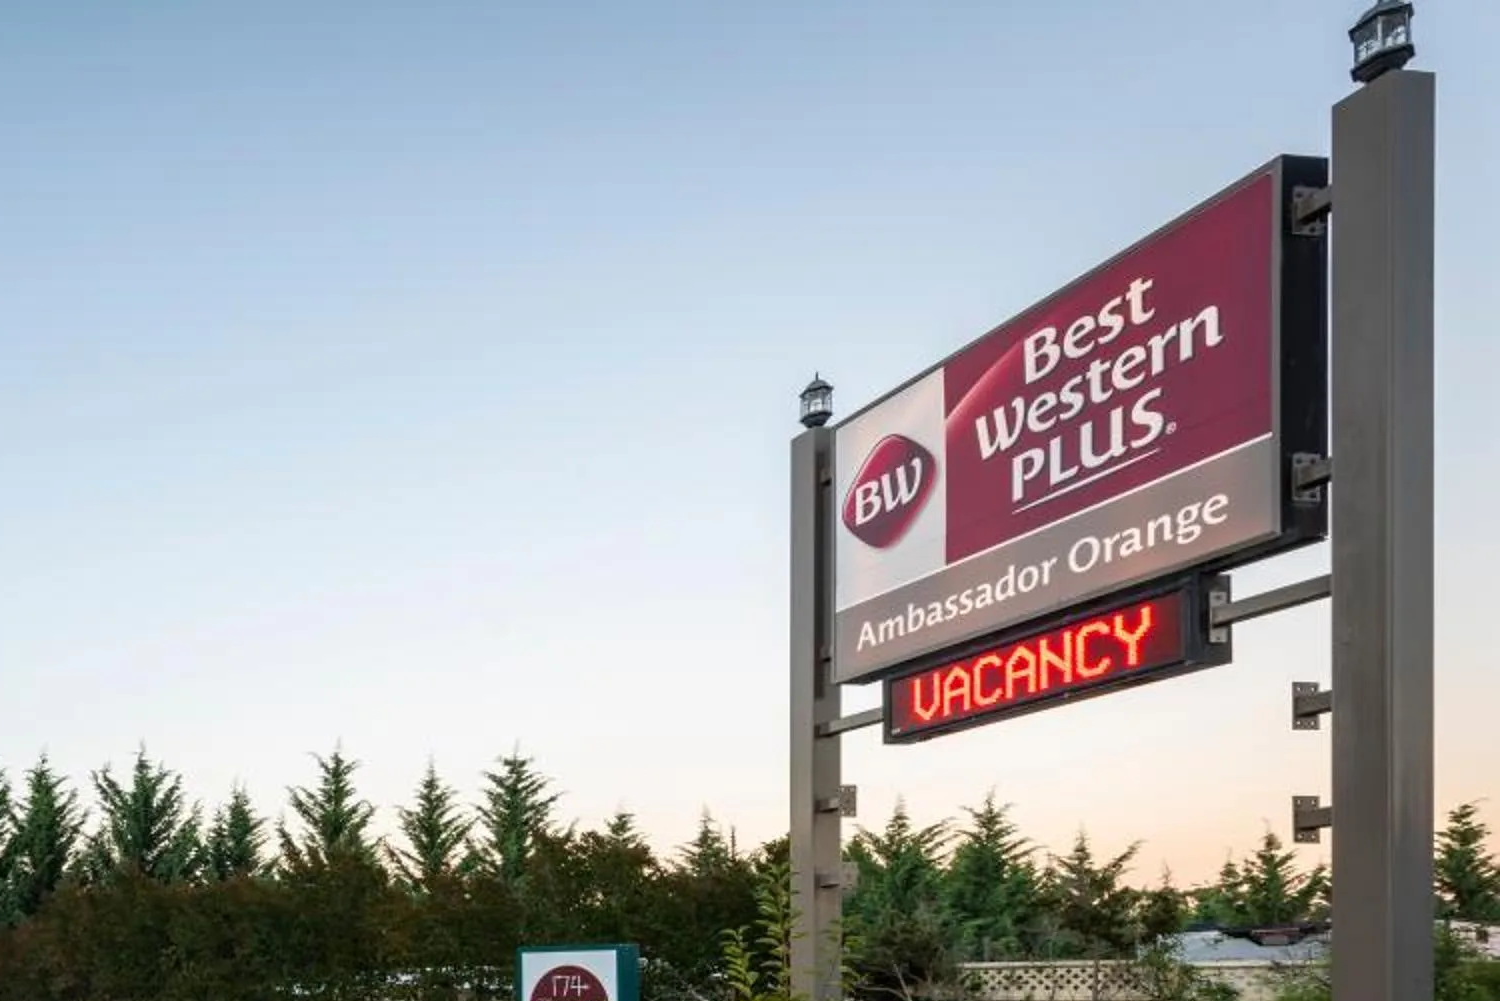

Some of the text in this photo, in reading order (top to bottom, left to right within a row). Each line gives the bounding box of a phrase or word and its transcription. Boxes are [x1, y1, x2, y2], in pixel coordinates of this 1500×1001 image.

[974, 305, 1223, 460] Western
[1023, 277, 1154, 384] Best
[853, 456, 924, 527] BW
[856, 493, 1229, 652] Ambassador Orange
[912, 605, 1153, 722] VACANCY
